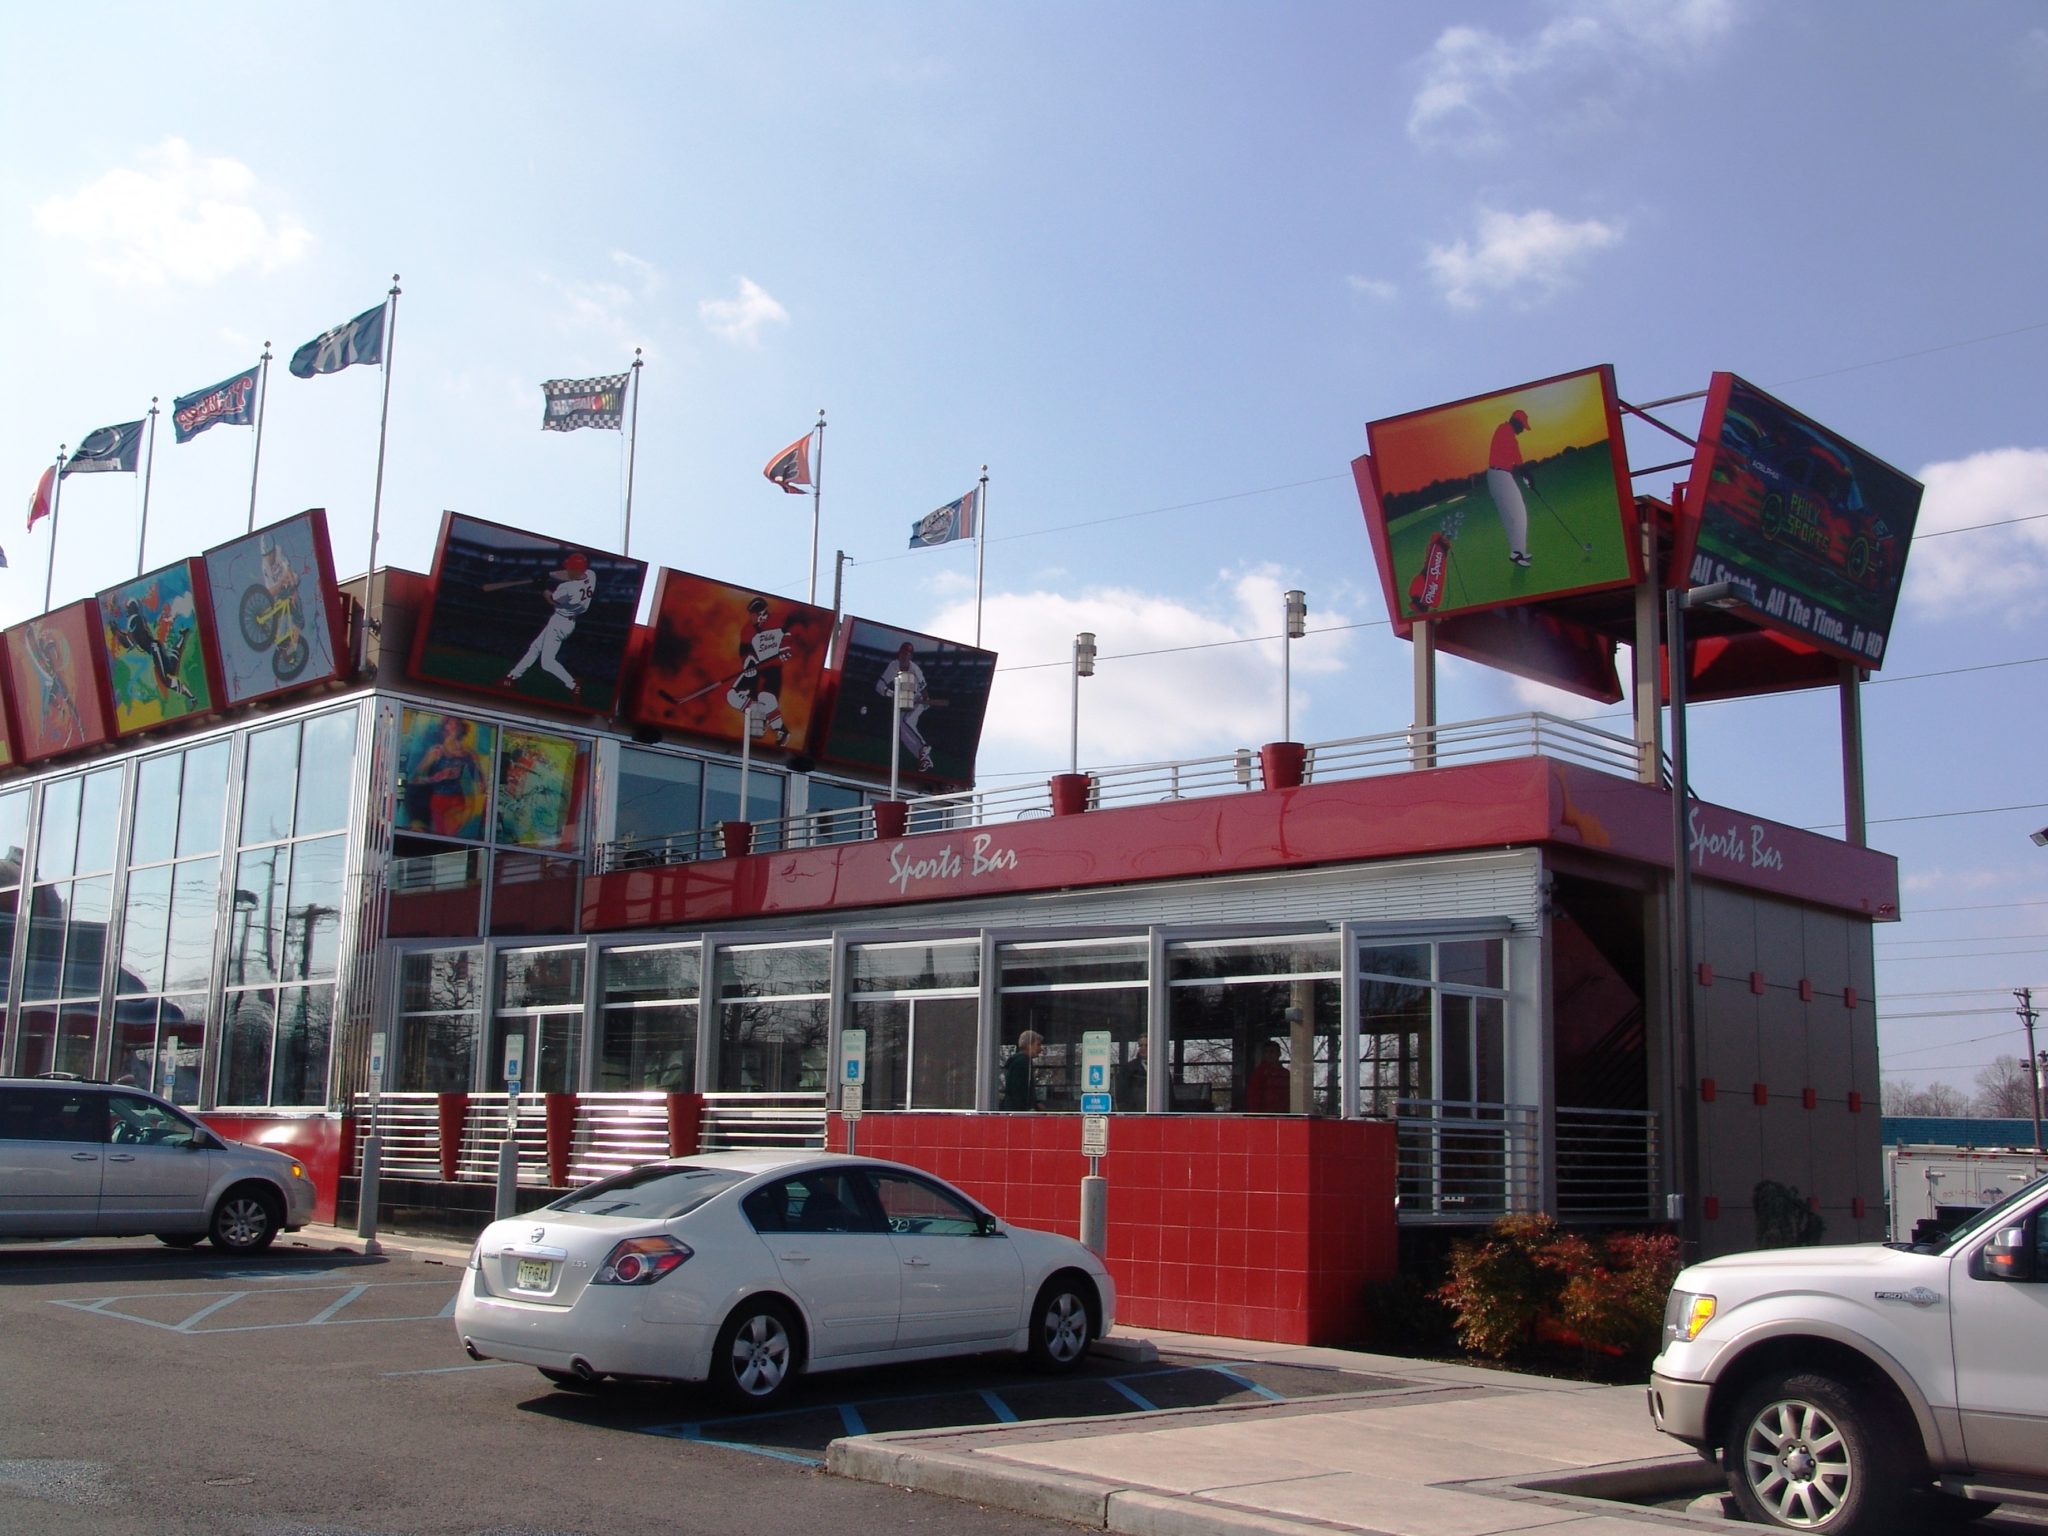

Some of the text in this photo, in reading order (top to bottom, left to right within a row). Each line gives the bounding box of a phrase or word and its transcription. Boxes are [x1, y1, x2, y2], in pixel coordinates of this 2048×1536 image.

[1787, 513, 1830, 553] SPORTS
[579, 586, 593, 601] 26
[1689, 554, 1713, 584] All
[1765, 587, 1787, 617] All
[1787, 594, 1810, 628] The
[1812, 607, 1848, 645] Time..
[1850, 625, 1864, 651] in
[1864, 631, 1884, 659] HD
[889, 833, 1018, 894] Sports Bar
[1688, 806, 1784, 871] Sports Bar
